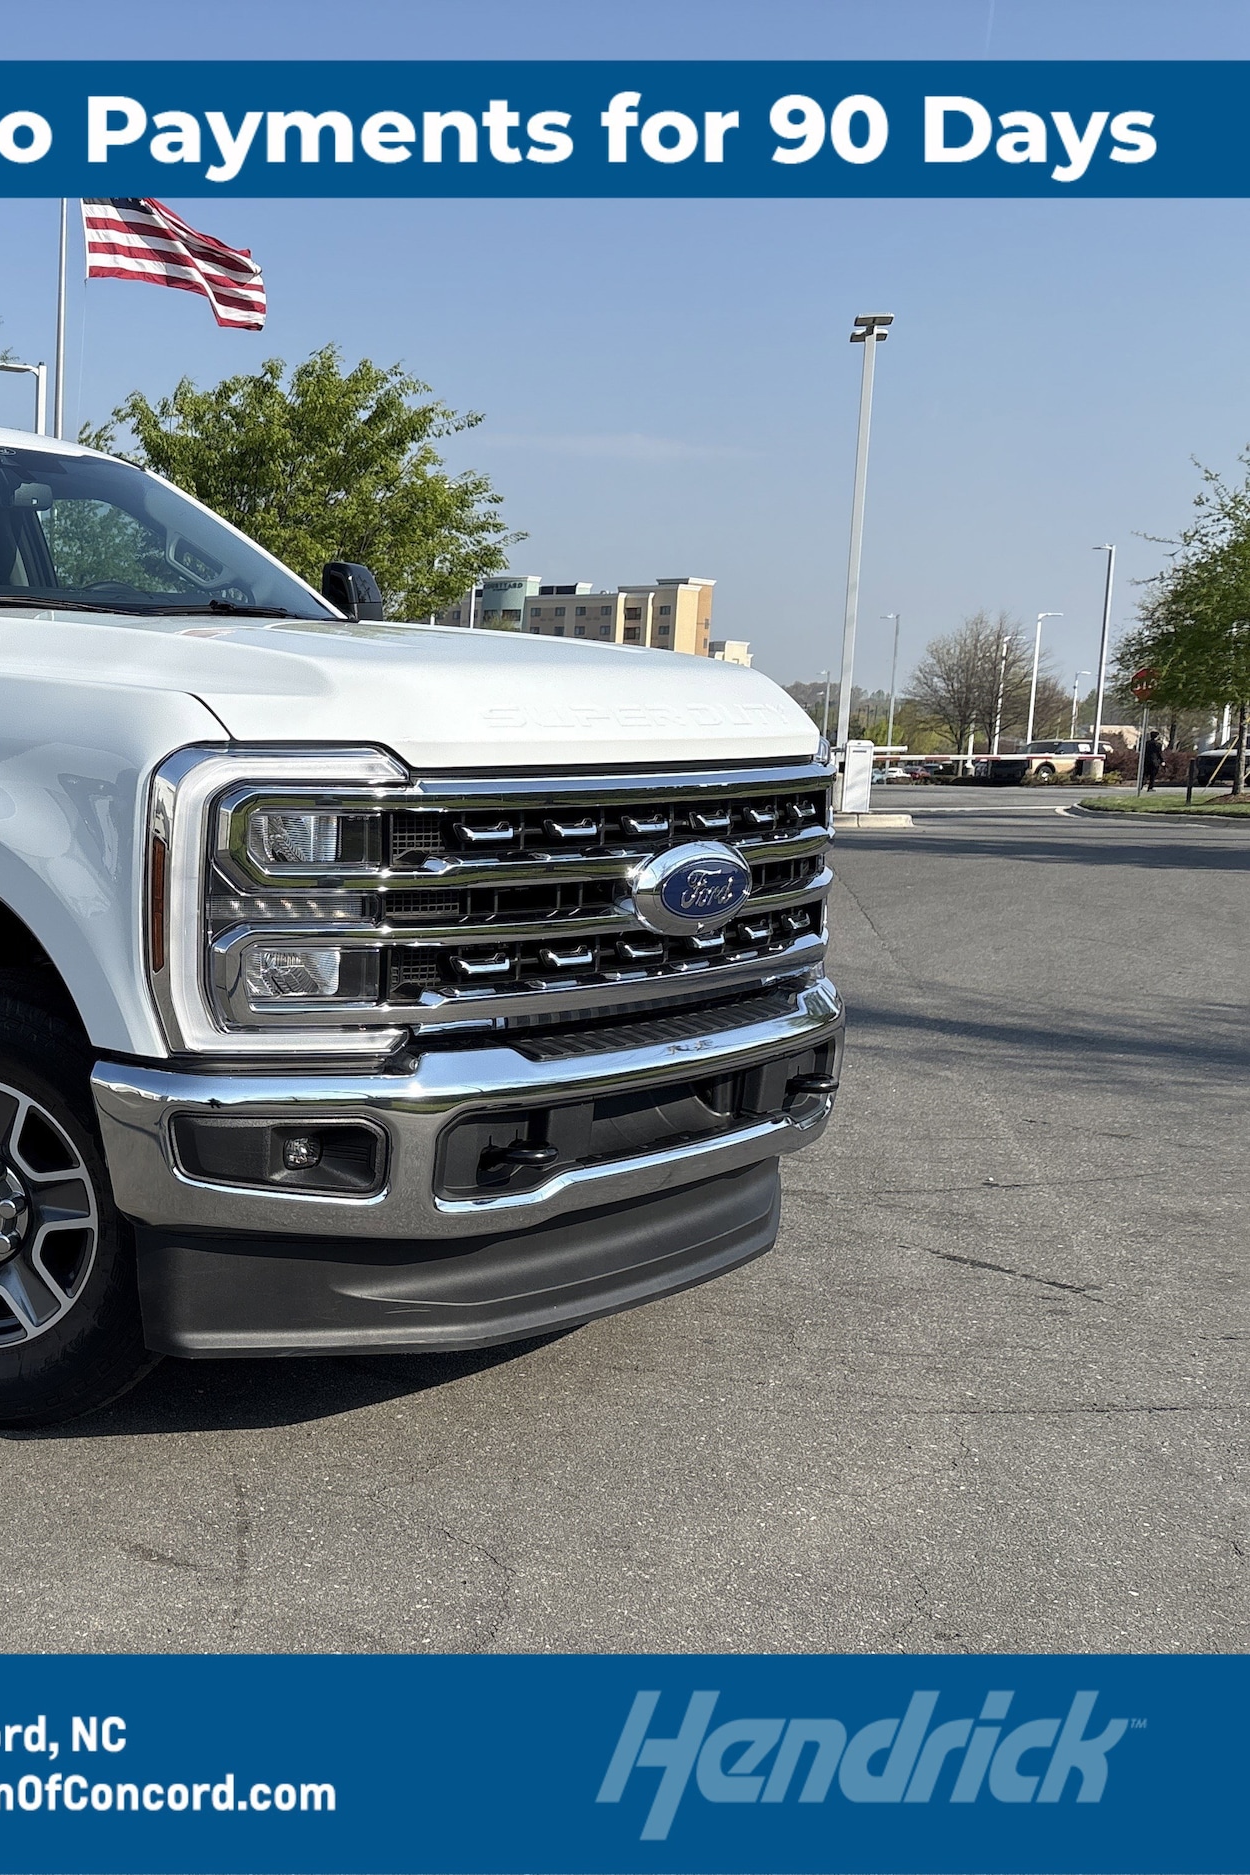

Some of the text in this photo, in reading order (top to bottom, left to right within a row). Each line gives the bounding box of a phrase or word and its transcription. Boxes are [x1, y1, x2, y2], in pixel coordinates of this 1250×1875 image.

[481, 703, 788, 728] SUPER DUTY
[680, 869, 734, 909] Ford
